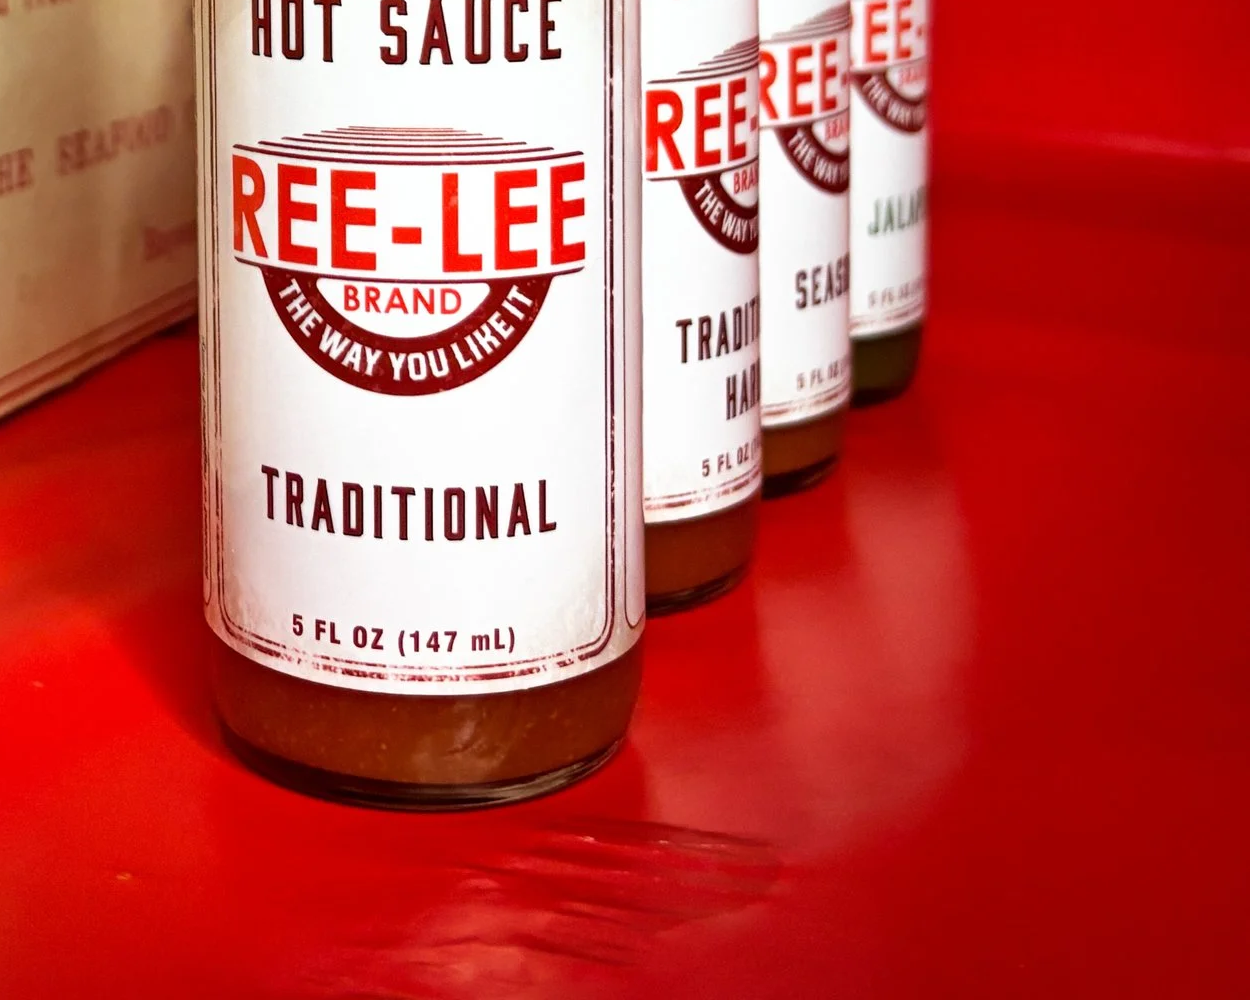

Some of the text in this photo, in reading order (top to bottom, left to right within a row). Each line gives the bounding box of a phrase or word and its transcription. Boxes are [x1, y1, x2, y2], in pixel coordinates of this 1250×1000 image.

[231, 154, 587, 274] REE-LEE
[694, 178, 725, 226] THE
[721, 209, 748, 244] WAY
[277, 278, 534, 382] THE WAY YOU LIKE IT
[343, 284, 463, 316] BRAND
[701, 457, 711, 478] 5
[717, 451, 732, 476] FL
[261, 464, 557, 542] TRADITIONAL
[292, 613, 516, 658] 5 FL OZ (147 mL)
